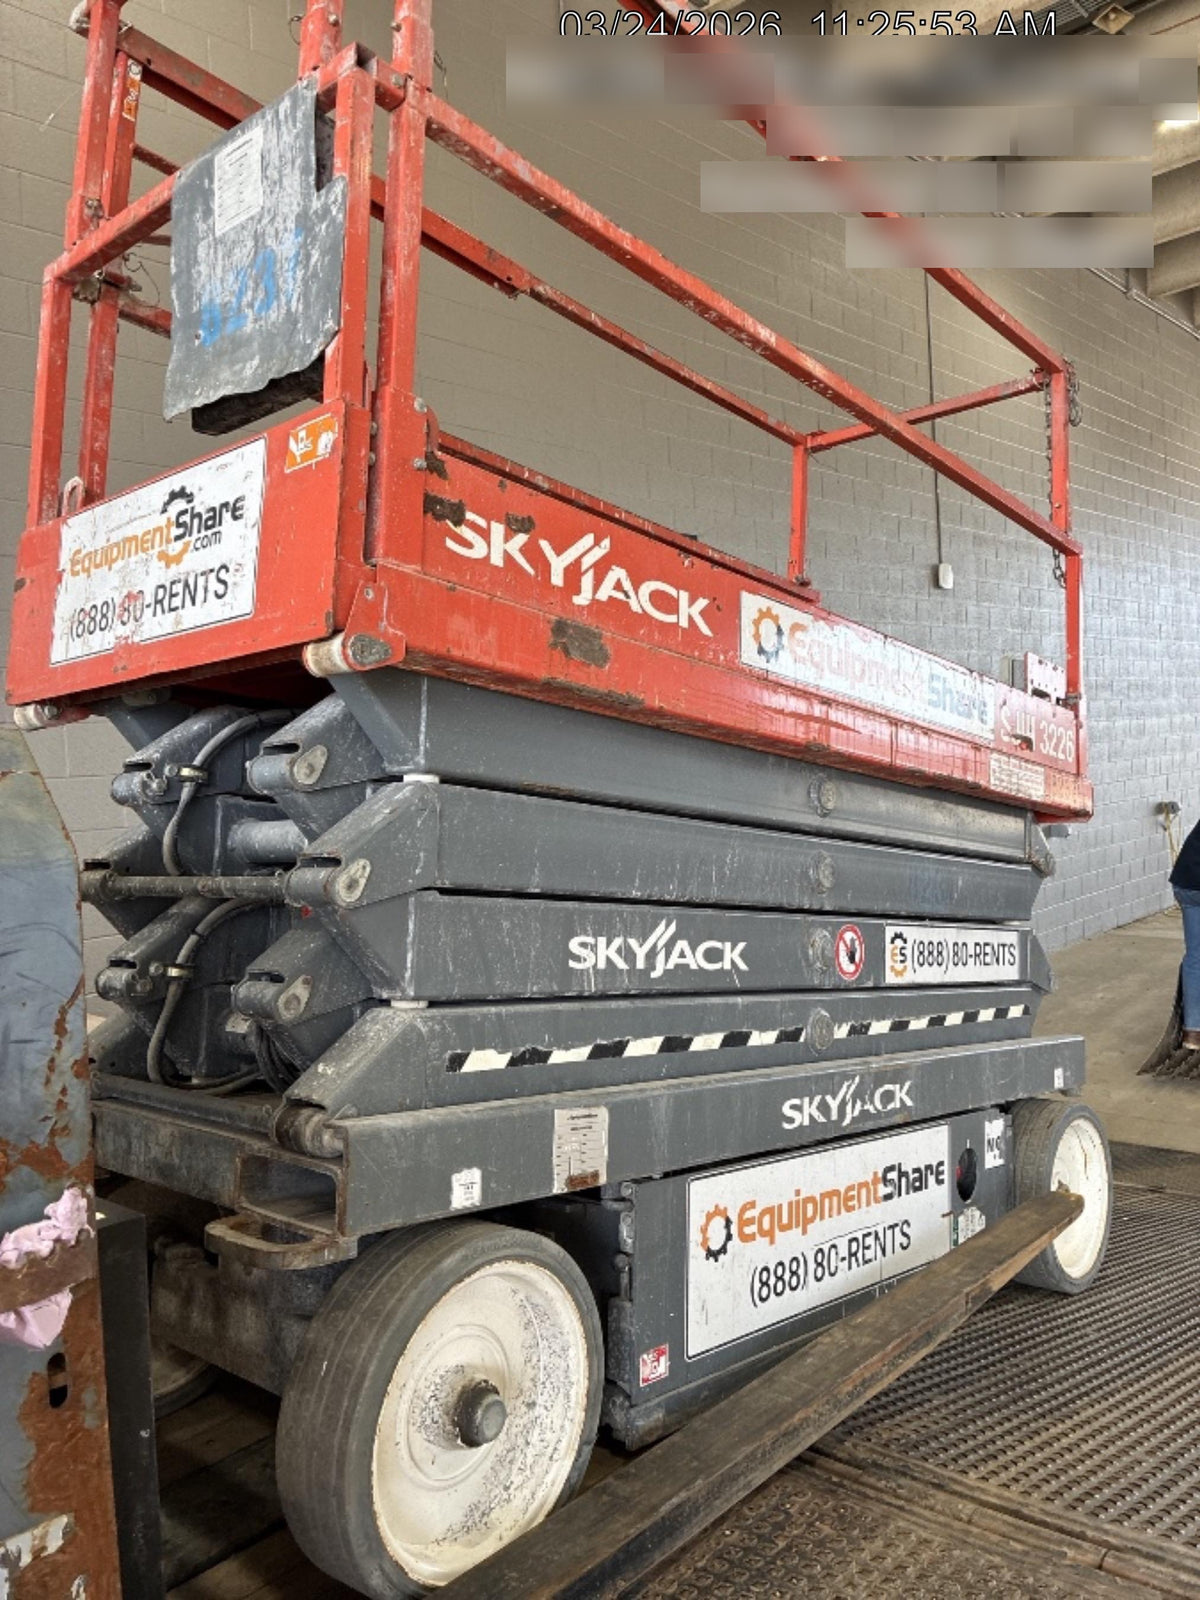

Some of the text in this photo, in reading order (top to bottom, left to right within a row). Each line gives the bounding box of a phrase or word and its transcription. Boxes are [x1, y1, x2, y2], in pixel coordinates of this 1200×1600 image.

[69, 494, 246, 577] EquipmentShare
[191, 530, 222, 552] .com
[445, 510, 713, 637] SKYJACK
[70, 596, 116, 642] (888)
[1039, 719, 1075, 764] 3226
[568, 918, 750, 979] SKYJACK
[911, 938, 1017, 974] (888) 80-RENTS
[781, 1074, 914, 1130] SKYJACK
[737, 1160, 945, 1246] EquipmentShare
[750, 1251, 808, 1309] (888)
[813, 1218, 912, 1284] 80-RENTS
